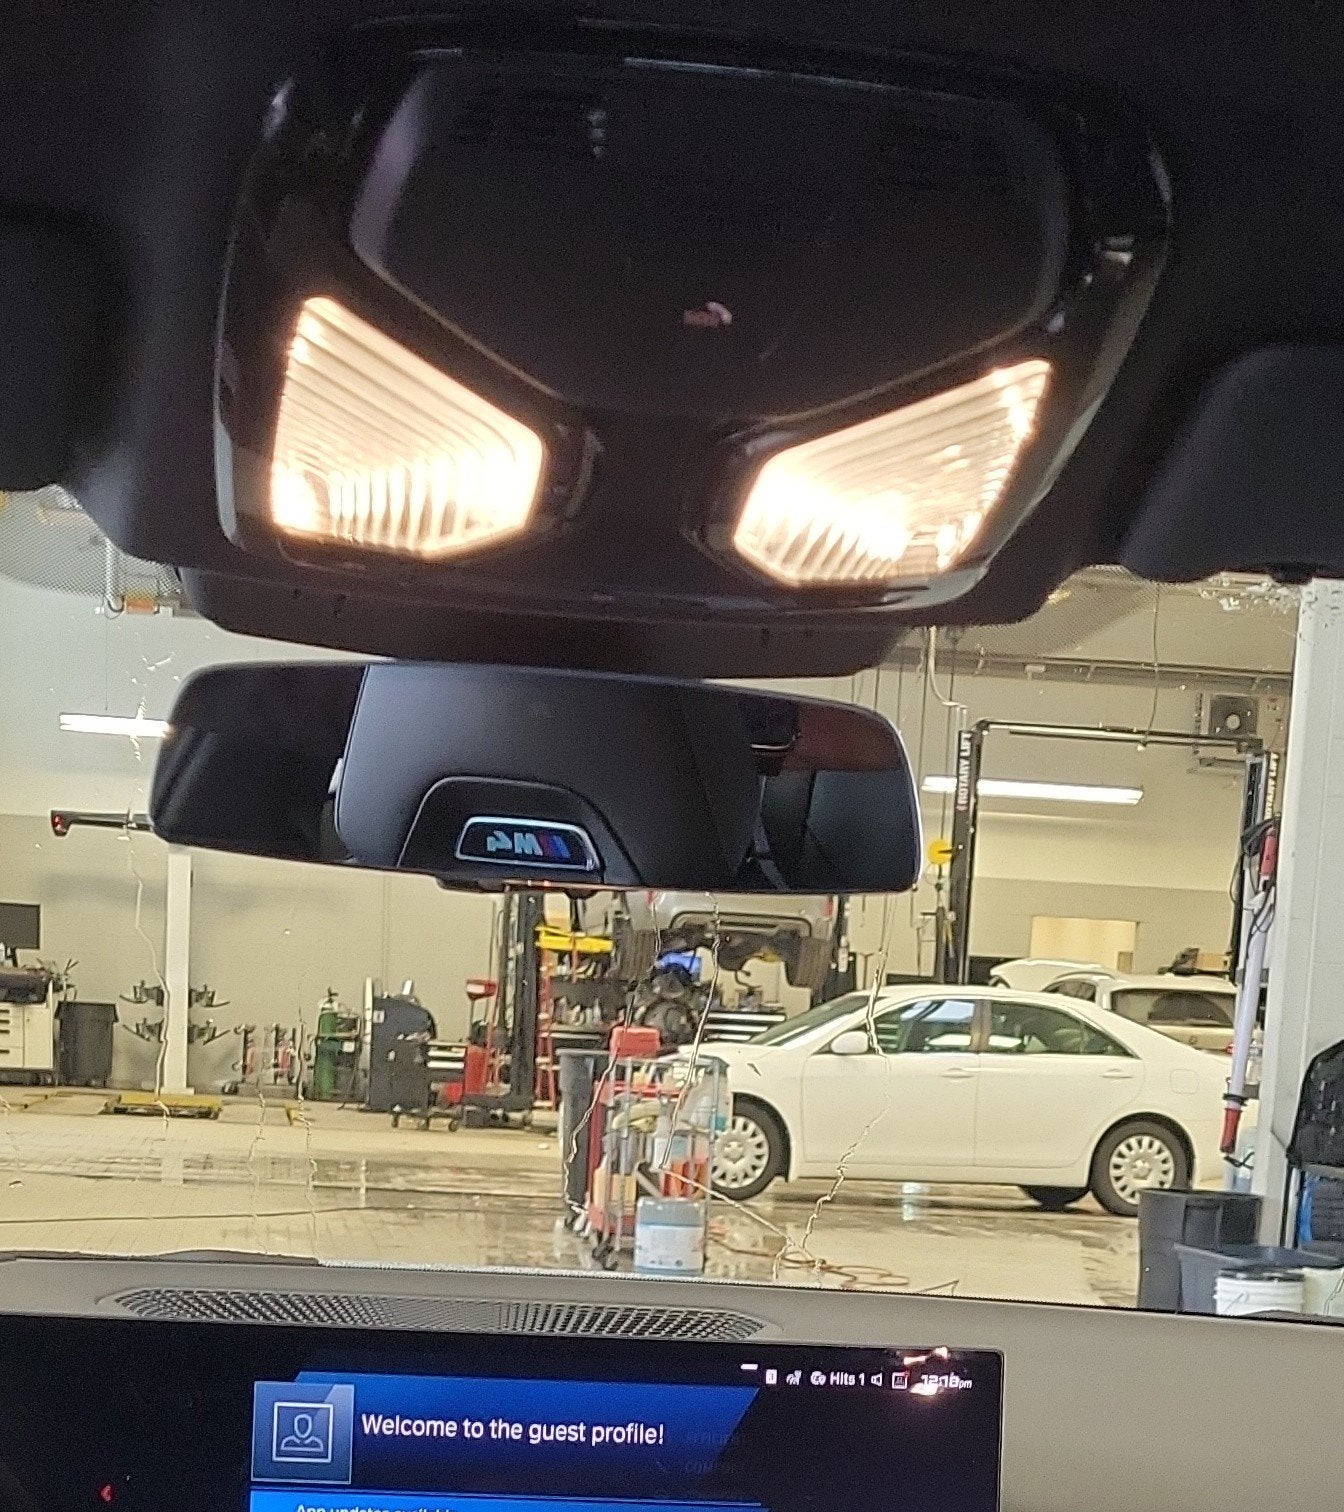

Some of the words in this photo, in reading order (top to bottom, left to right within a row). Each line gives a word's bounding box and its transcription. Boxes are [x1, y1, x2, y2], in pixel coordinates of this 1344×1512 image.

[830, 1371, 855, 1386] Hits
[361, 1413, 457, 1438] Welcome
[463, 1418, 484, 1439] to
[489, 1418, 523, 1440] the
[528, 1421, 586, 1445] guest
[591, 1422, 664, 1447] profile!
